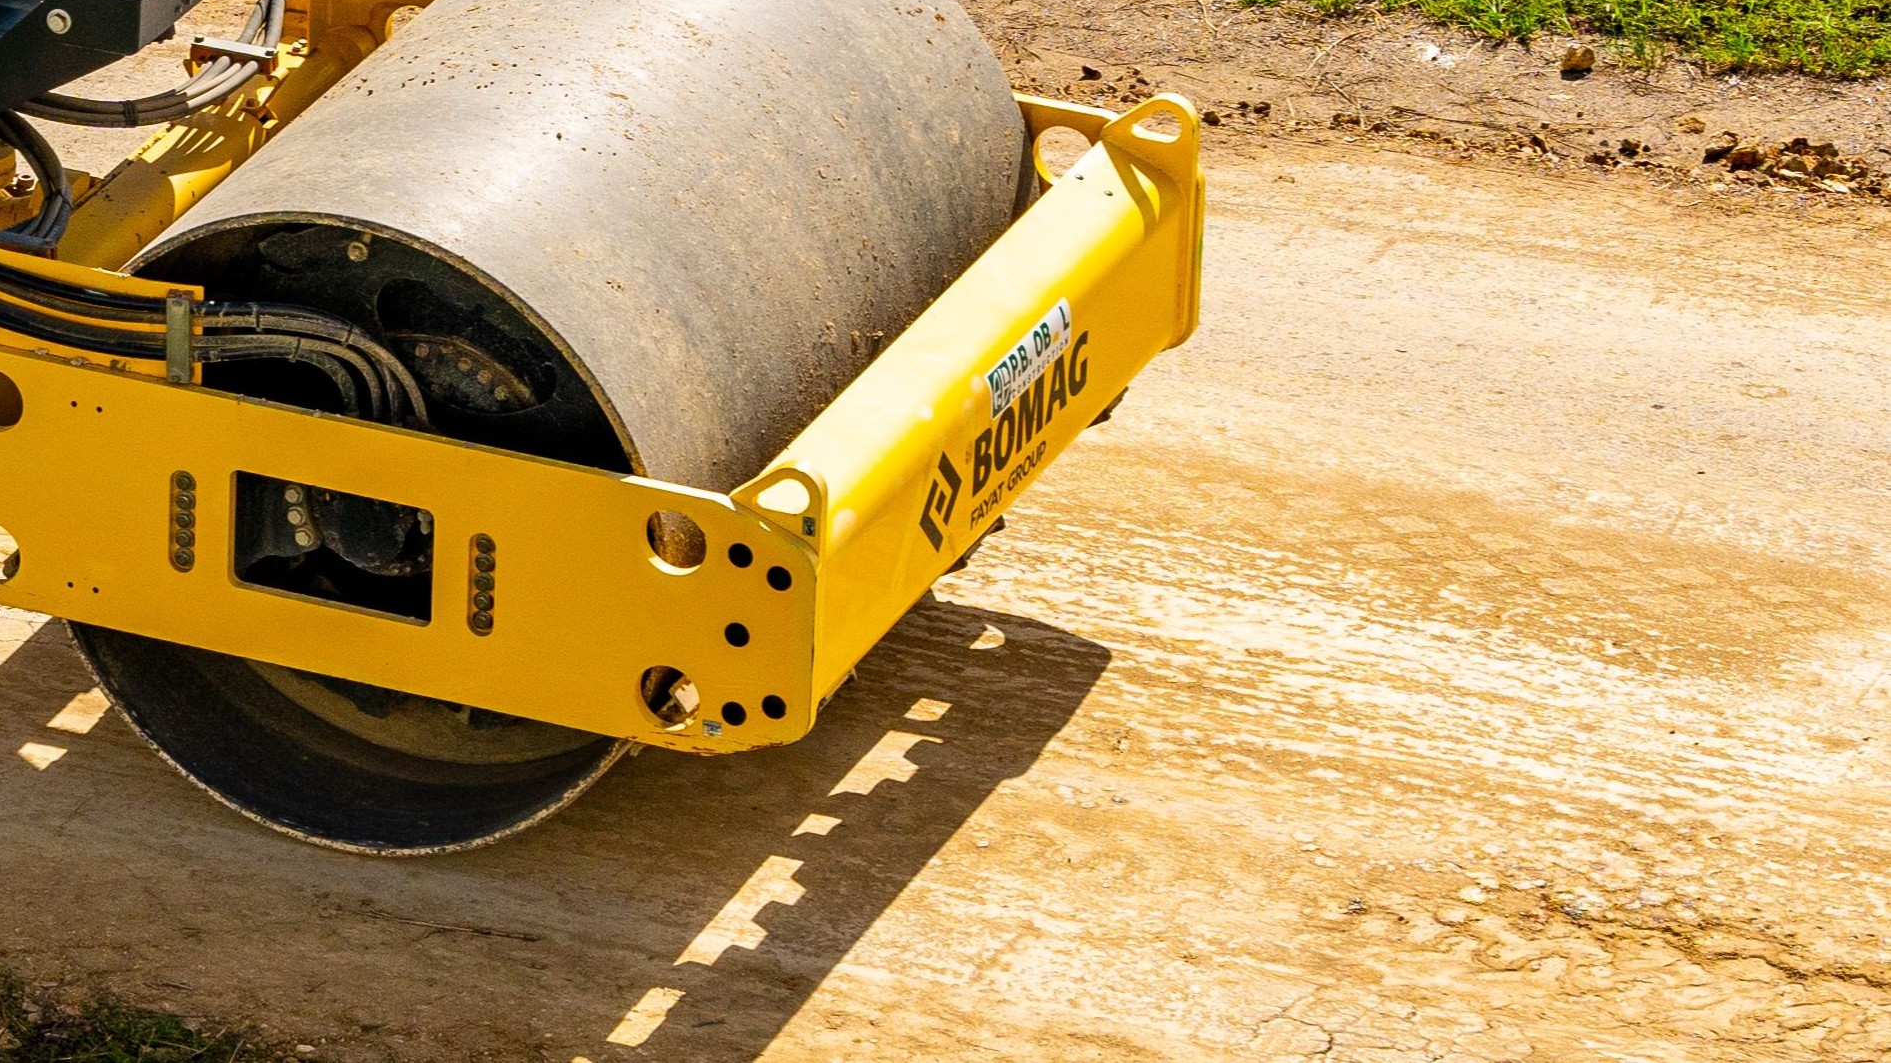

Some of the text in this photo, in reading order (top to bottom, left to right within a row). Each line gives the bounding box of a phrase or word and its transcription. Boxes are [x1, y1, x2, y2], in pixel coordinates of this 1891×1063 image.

[1008, 344, 1032, 383] P.B.
[972, 330, 1089, 498] BOMAG
[970, 439, 1047, 531] FAYAT GROUP
